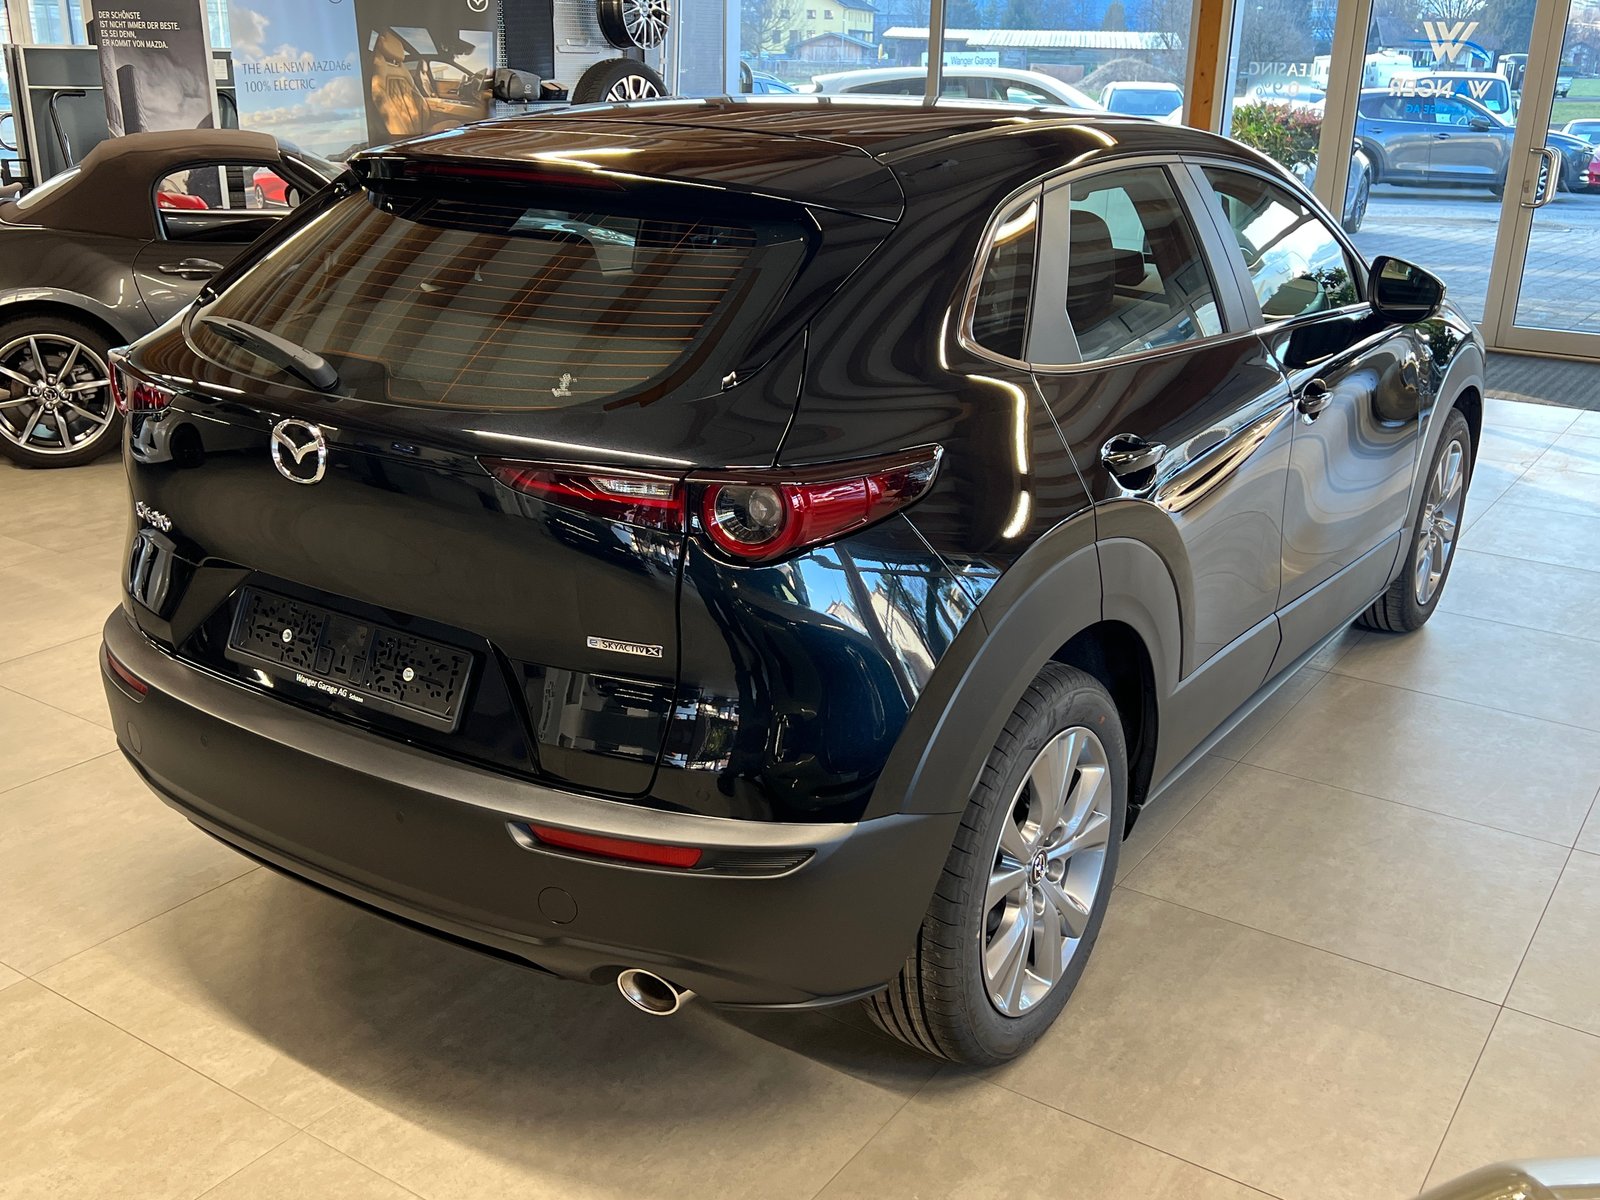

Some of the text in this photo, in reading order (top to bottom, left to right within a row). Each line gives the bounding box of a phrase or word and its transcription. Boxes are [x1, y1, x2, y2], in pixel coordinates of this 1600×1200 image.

[98, 10, 141, 20] DER SCHÖNSTE
[109, 21, 126, 29] NICHT
[127, 21, 146, 29] IMMER
[160, 22, 181, 30] BESTE.
[110, 39, 131, 47] KOMMT
[132, 40, 145, 48] VON
[145, 40, 169, 49] MAZDA.
[951, 56, 997, 67] Wanger Garage
[242, 63, 262, 75] THE
[263, 61, 305, 74] ALL-NEW
[307, 60, 352, 72] MAZDA6e
[244, 78, 316, 93] 100% ELECTRIC
[296, 673, 318, 687] Wanger
[318, 681, 337, 694] Garage
[337, 688, 348, 697] AG
